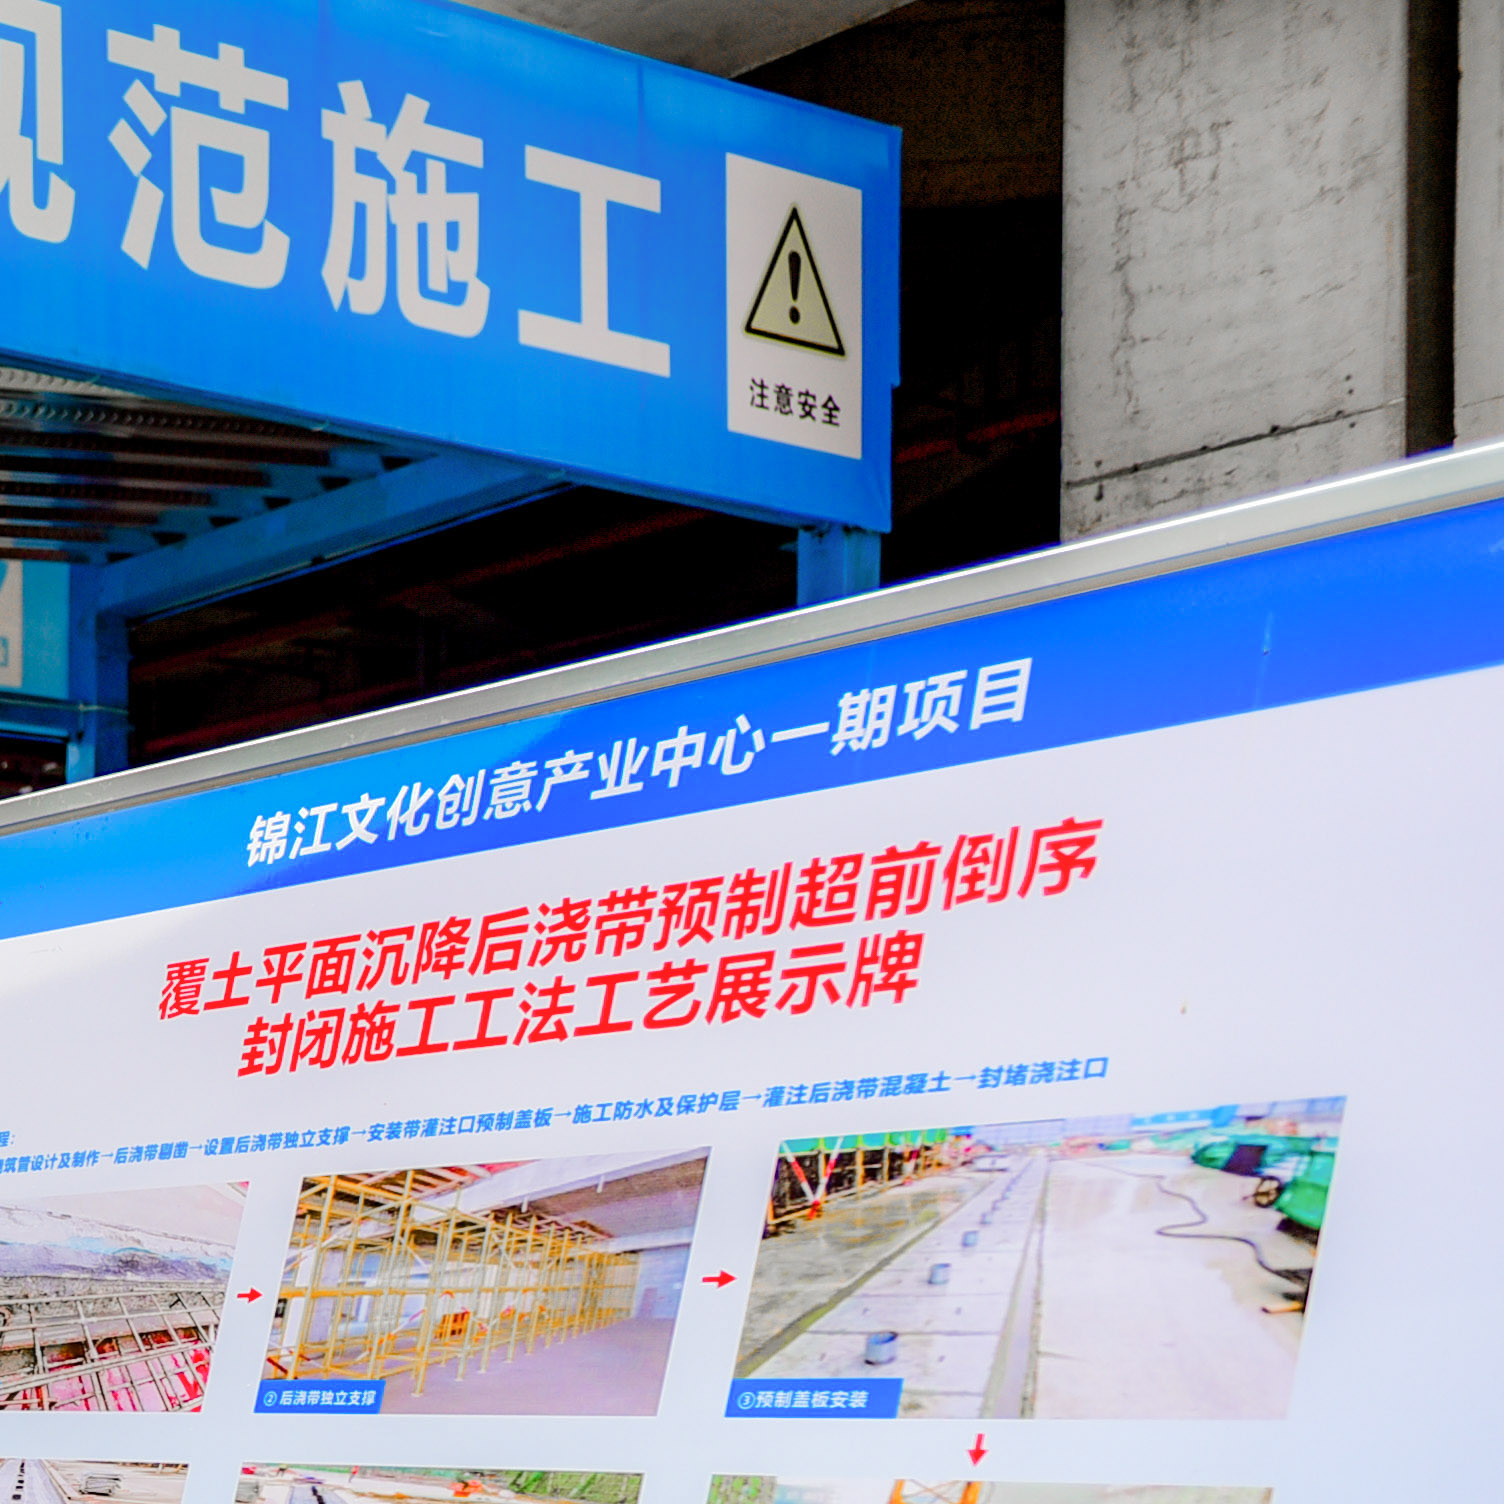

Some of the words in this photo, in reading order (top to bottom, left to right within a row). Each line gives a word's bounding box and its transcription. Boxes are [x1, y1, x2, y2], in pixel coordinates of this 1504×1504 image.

[750, 378, 840, 427] 注意安全
[246, 658, 1033, 868] 锦江文化创意产业中心一期项目
[158, 818, 1103, 1022] 覆土平面沉降后浇带预制超前倒序
[237, 931, 923, 1078] 封闭施工工法工艺展示牌
[737, 1389, 868, 1411] ③预制盖板安装
